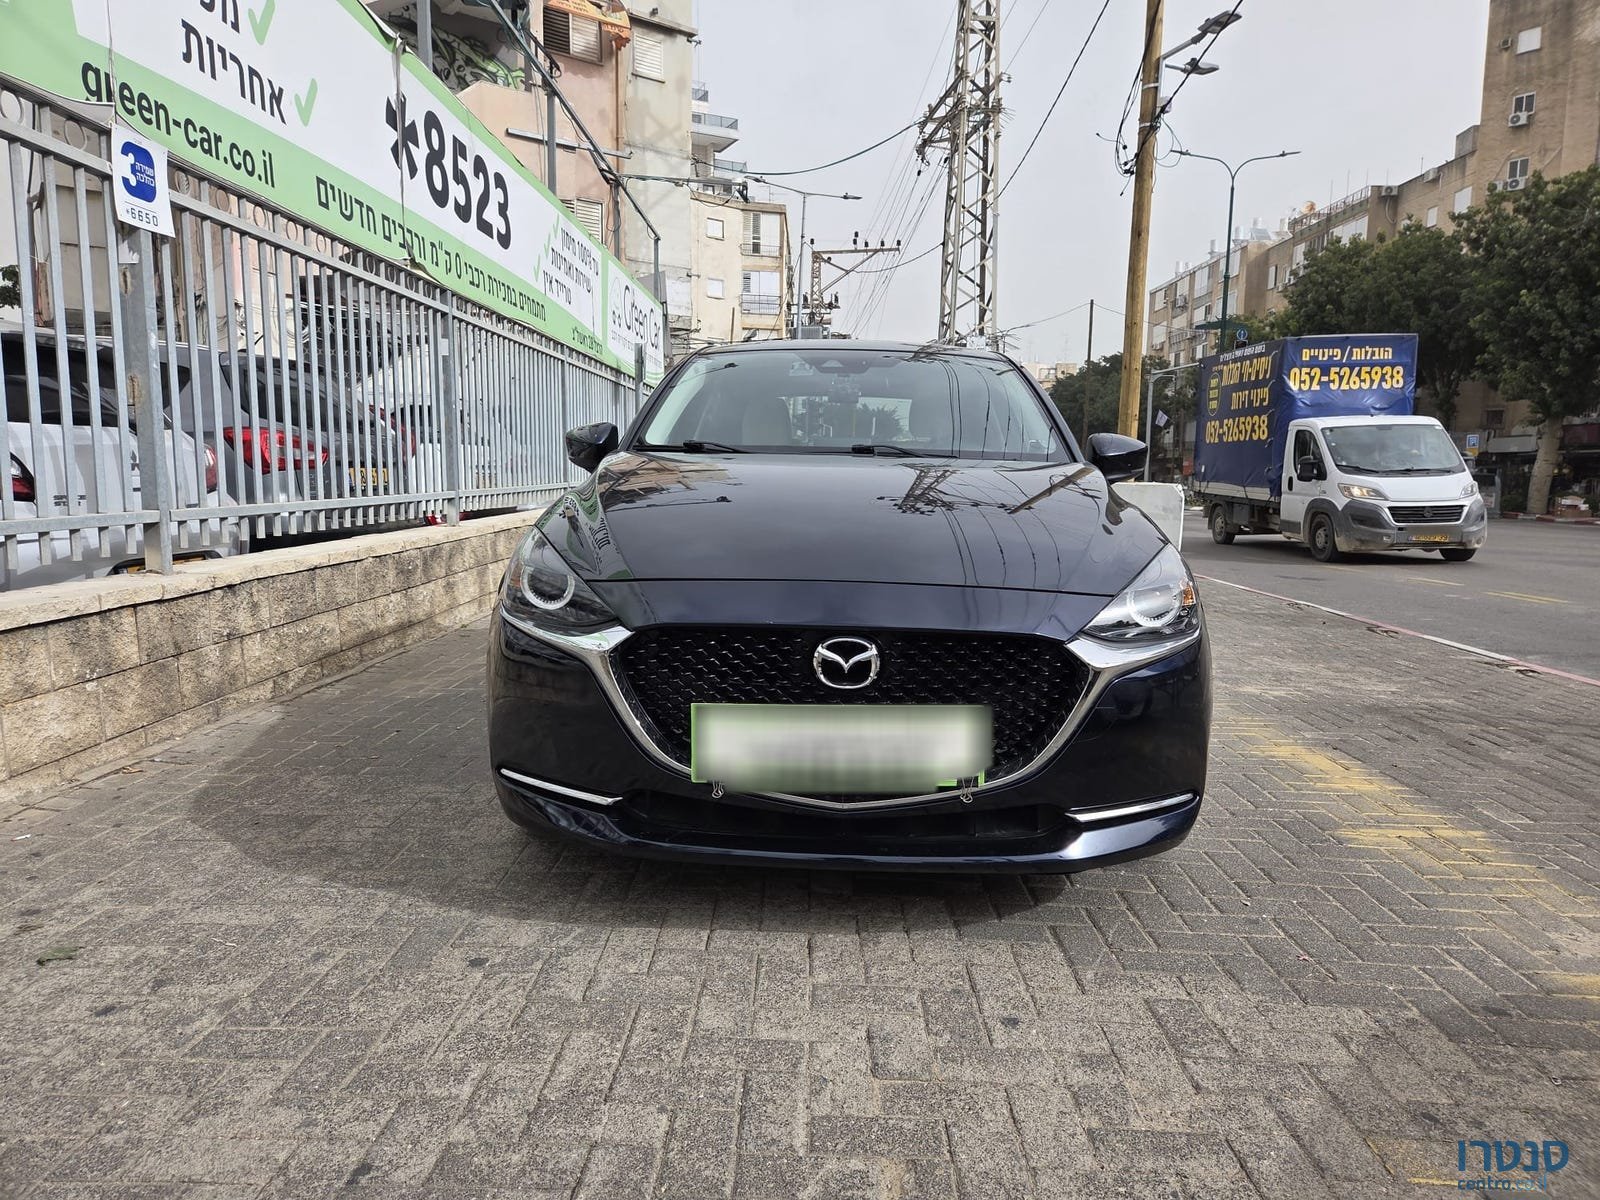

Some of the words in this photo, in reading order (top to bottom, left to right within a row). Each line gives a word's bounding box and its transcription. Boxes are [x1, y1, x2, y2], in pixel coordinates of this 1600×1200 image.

[181, 19, 287, 125] אחריות
[136, 172, 155, 187] כהלכה
[316, 176, 377, 235] חדשים
[381, 213, 426, 261] ורכבים
[464, 262, 486, 291] רכבי
[487, 274, 518, 307] במכירת
[519, 291, 546, 321] מתמחים
[624, 285, 648, 343] Green
[1290, 366, 1404, 391] 052-5265938
[1231, 390, 1249, 410] דירות
[1250, 387, 1269, 407] פינוי
[1205, 415, 1268, 444] 052-5265938
